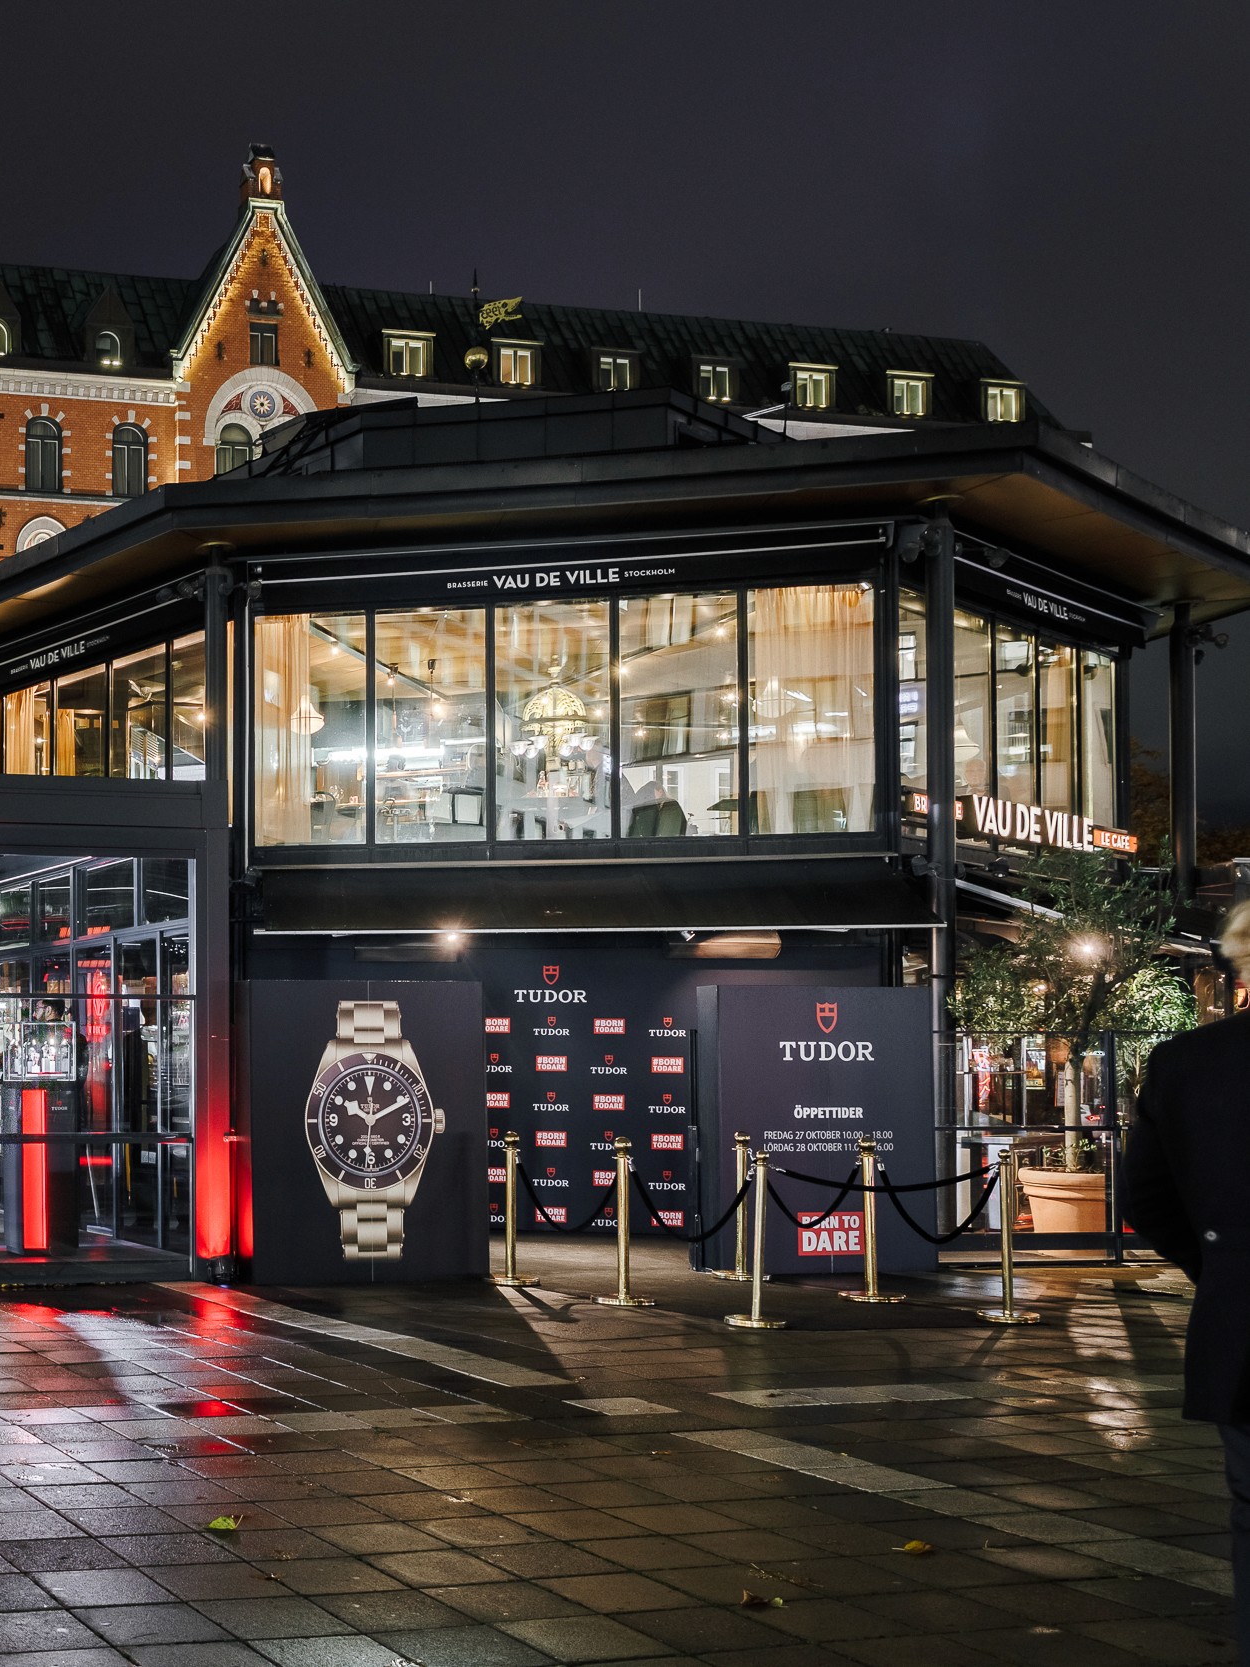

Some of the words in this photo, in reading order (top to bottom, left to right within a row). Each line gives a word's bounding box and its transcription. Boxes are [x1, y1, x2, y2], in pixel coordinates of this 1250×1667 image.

[447, 580, 488, 589] BRASSERIE
[493, 574, 530, 589] VAU
[536, 572, 560, 587] DE
[566, 568, 619, 584] VILLE
[624, 568, 675, 577] STOCKHOLM
[1023, 592, 1036, 609] VAU
[1038, 597, 1048, 613] DE
[1049, 601, 1068, 620] VILLE
[30, 655, 46, 669] VAU
[48, 650, 59, 665] DE
[61, 641, 85, 659] VILLE
[973, 794, 1012, 837] VAU
[1016, 803, 1041, 843] DE
[1045, 810, 1093, 852] VILLE
[1101, 831, 1110, 846] LE
[514, 990, 587, 1003] TUDOR
[485, 1018, 509, 1026] BORN
[595, 1019, 623, 1027] #BORN
[534, 1028, 569, 1036] TUDOR
[649, 1029, 686, 1037] TUDOR
[779, 1041, 874, 1061] TUDOR
[537, 1056, 566, 1064] #BORN
[653, 1058, 681, 1066] #BORN
[537, 1063, 566, 1071] TODARE
[313, 1082, 327, 1097] 50
[415, 1083, 424, 1095] 10
[594, 1095, 623, 1103] #BORN
[533, 1103, 569, 1112] TUDOR
[649, 1106, 686, 1114] TUDOR
[794, 1104, 863, 1119] ÖPPETTIDER
[329, 1114, 338, 1126] 9
[402, 1114, 411, 1126] 3
[537, 1131, 565, 1140] #BORN
[764, 1131, 793, 1139] FREDAG
[795, 1131, 804, 1139] 27
[806, 1131, 840, 1139] OKTOBER
[843, 1131, 863, 1139] 10.00
[873, 1131, 893, 1139] 18.00
[314, 1145, 327, 1159] 40
[413, 1144, 426, 1159] 20
[764, 1143, 794, 1151] LÖRDAG
[796, 1143, 805, 1151] 28
[808, 1143, 842, 1151] OKTOBER
[844, 1143, 859, 1151] 11.0
[368, 1152, 375, 1164] 6
[365, 1178, 377, 1189] 30
[533, 1179, 569, 1187] TUDOR
[648, 1182, 686, 1190] TUDOR
[842, 1215, 860, 1228] TO
[802, 1231, 860, 1251] DARE
